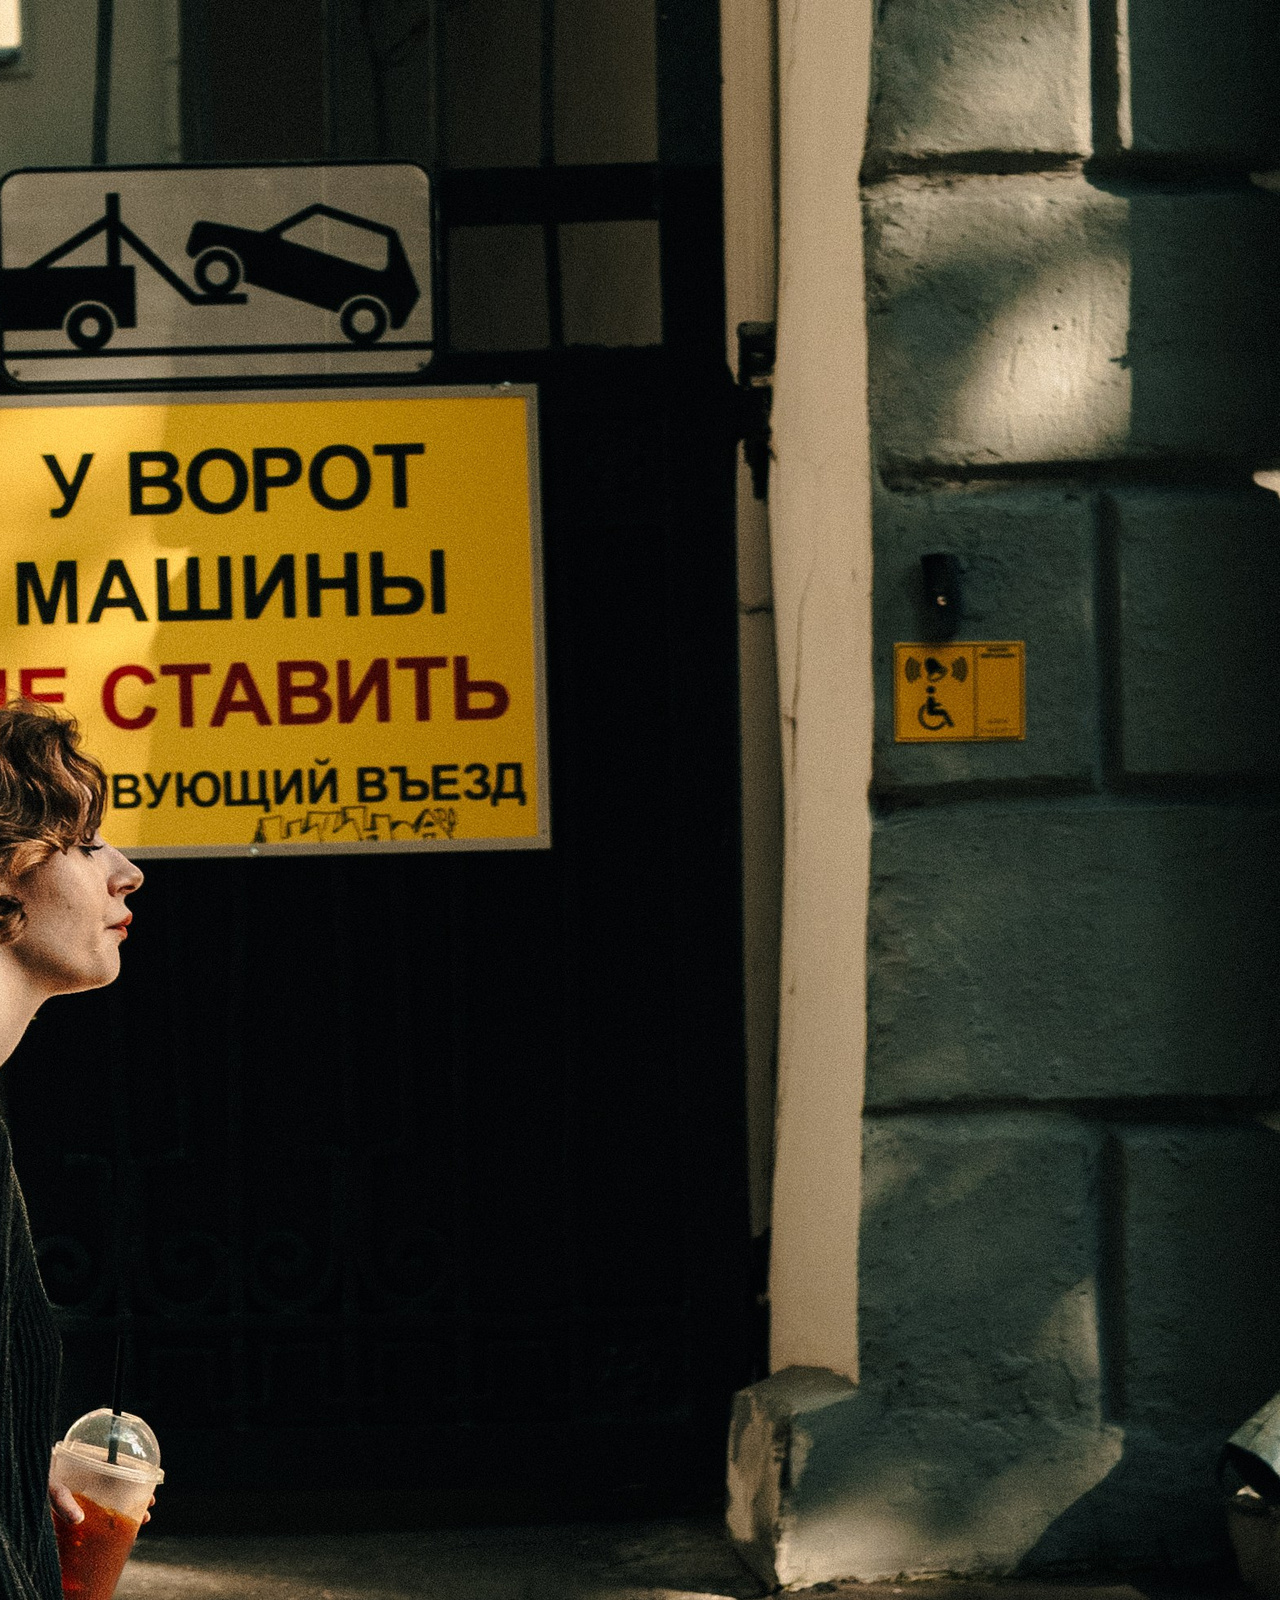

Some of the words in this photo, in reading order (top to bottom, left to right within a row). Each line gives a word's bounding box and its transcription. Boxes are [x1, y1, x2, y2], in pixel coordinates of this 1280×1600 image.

[42, 452, 94, 519] У
[128, 442, 426, 516] ВОРОТ
[15, 549, 446, 626] МАШИНЫ
[100, 656, 511, 731] СТАВИТЬ
[110, 757, 338, 813] ВУЮЩИЙ
[356, 762, 527, 807] ВЪЕЗД
